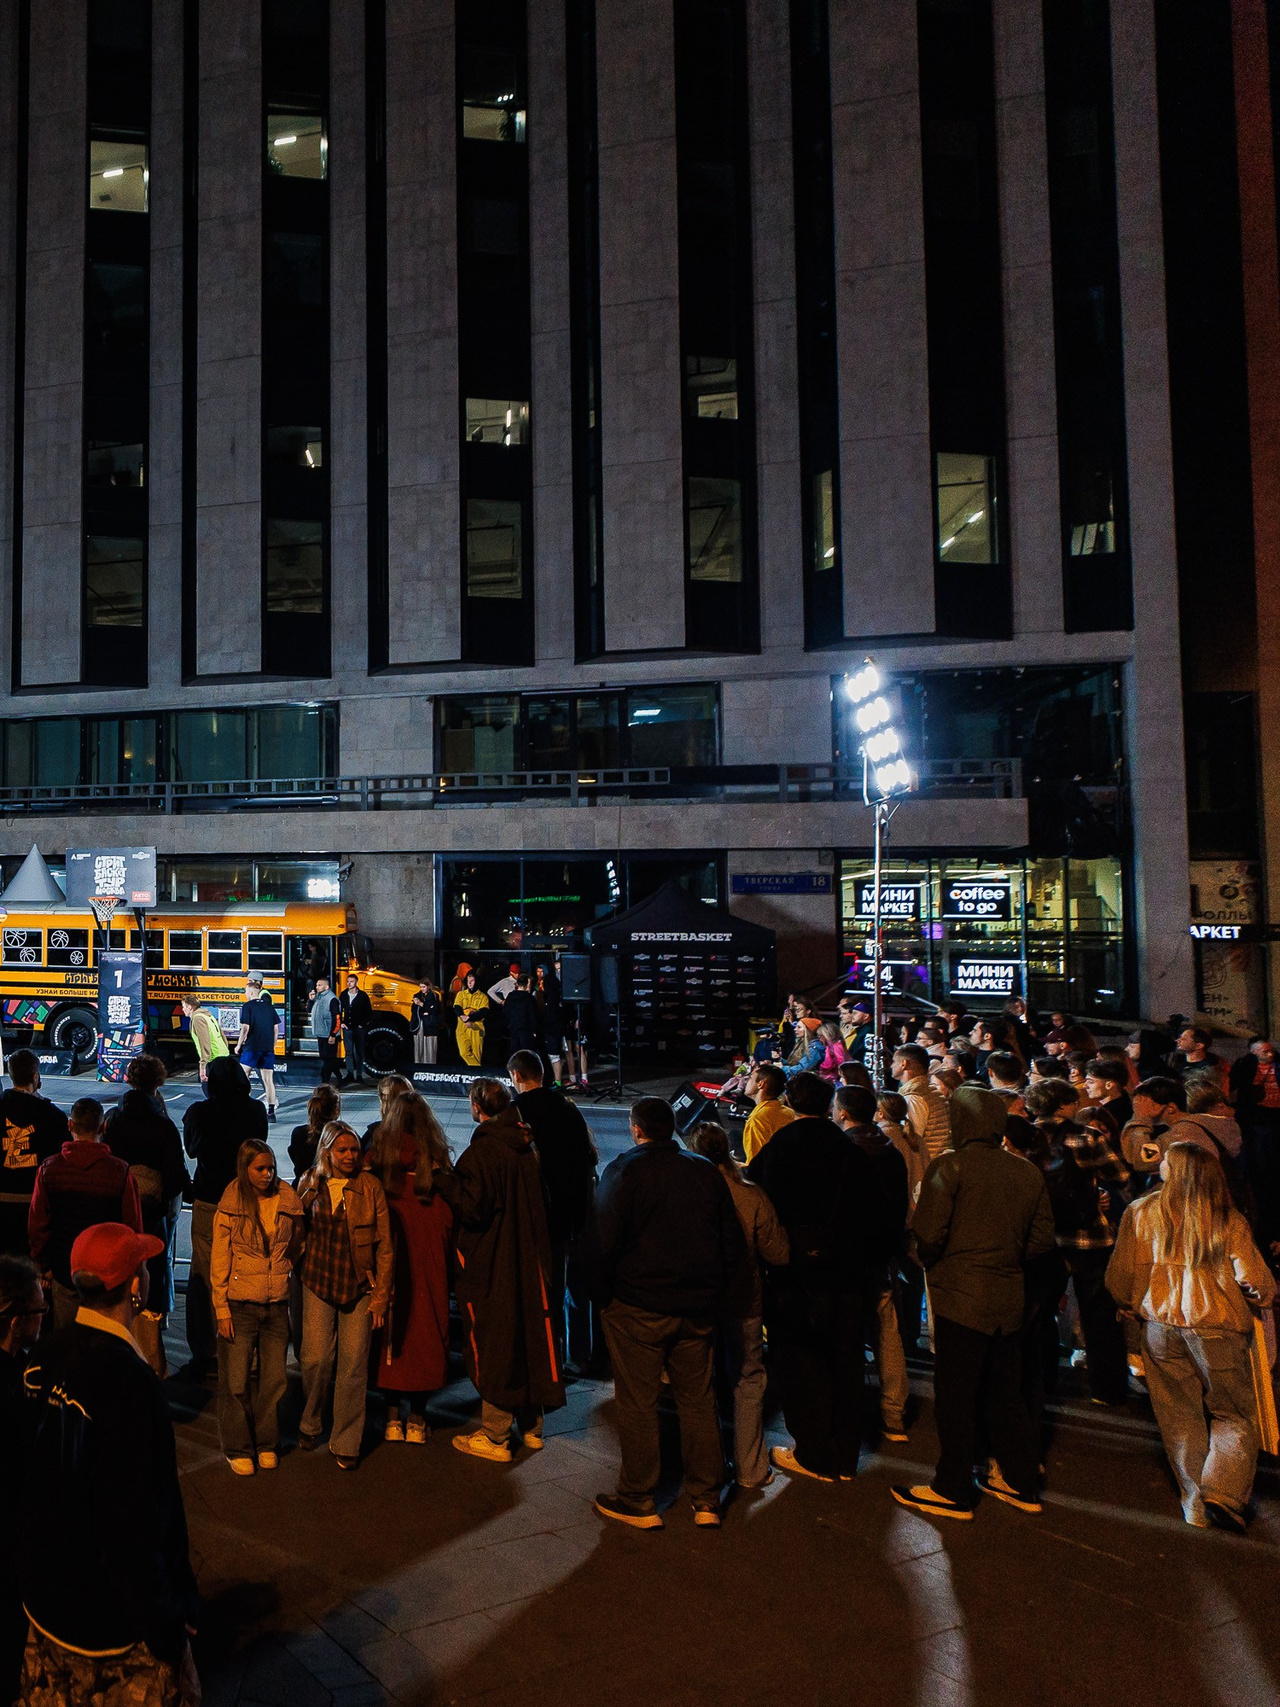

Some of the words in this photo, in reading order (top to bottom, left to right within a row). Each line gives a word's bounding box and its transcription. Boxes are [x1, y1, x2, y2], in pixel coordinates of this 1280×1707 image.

[95, 856, 125, 868] СТРИТ
[744, 876, 795, 884] ТВЕРСКАЯ
[812, 876, 826, 886] 18
[862, 889, 915, 901] МИНИ
[949, 887, 1005, 900] coffee
[958, 902, 973, 912] to
[976, 903, 997, 914] go
[1203, 910, 1252, 920] ОЛЛЫ
[630, 932, 733, 942] STREETBASKET
[1189, 925, 1241, 938] АРКЕТ
[958, 965, 1014, 977] МИНИ
[65, 973, 99, 984] СТРИТБ
[156, 974, 200, 987] МОСКВА
[114, 969, 123, 988] 1
[957, 979, 1013, 990] МАРКЕТ
[38, 1055, 58, 1064] СКВА
